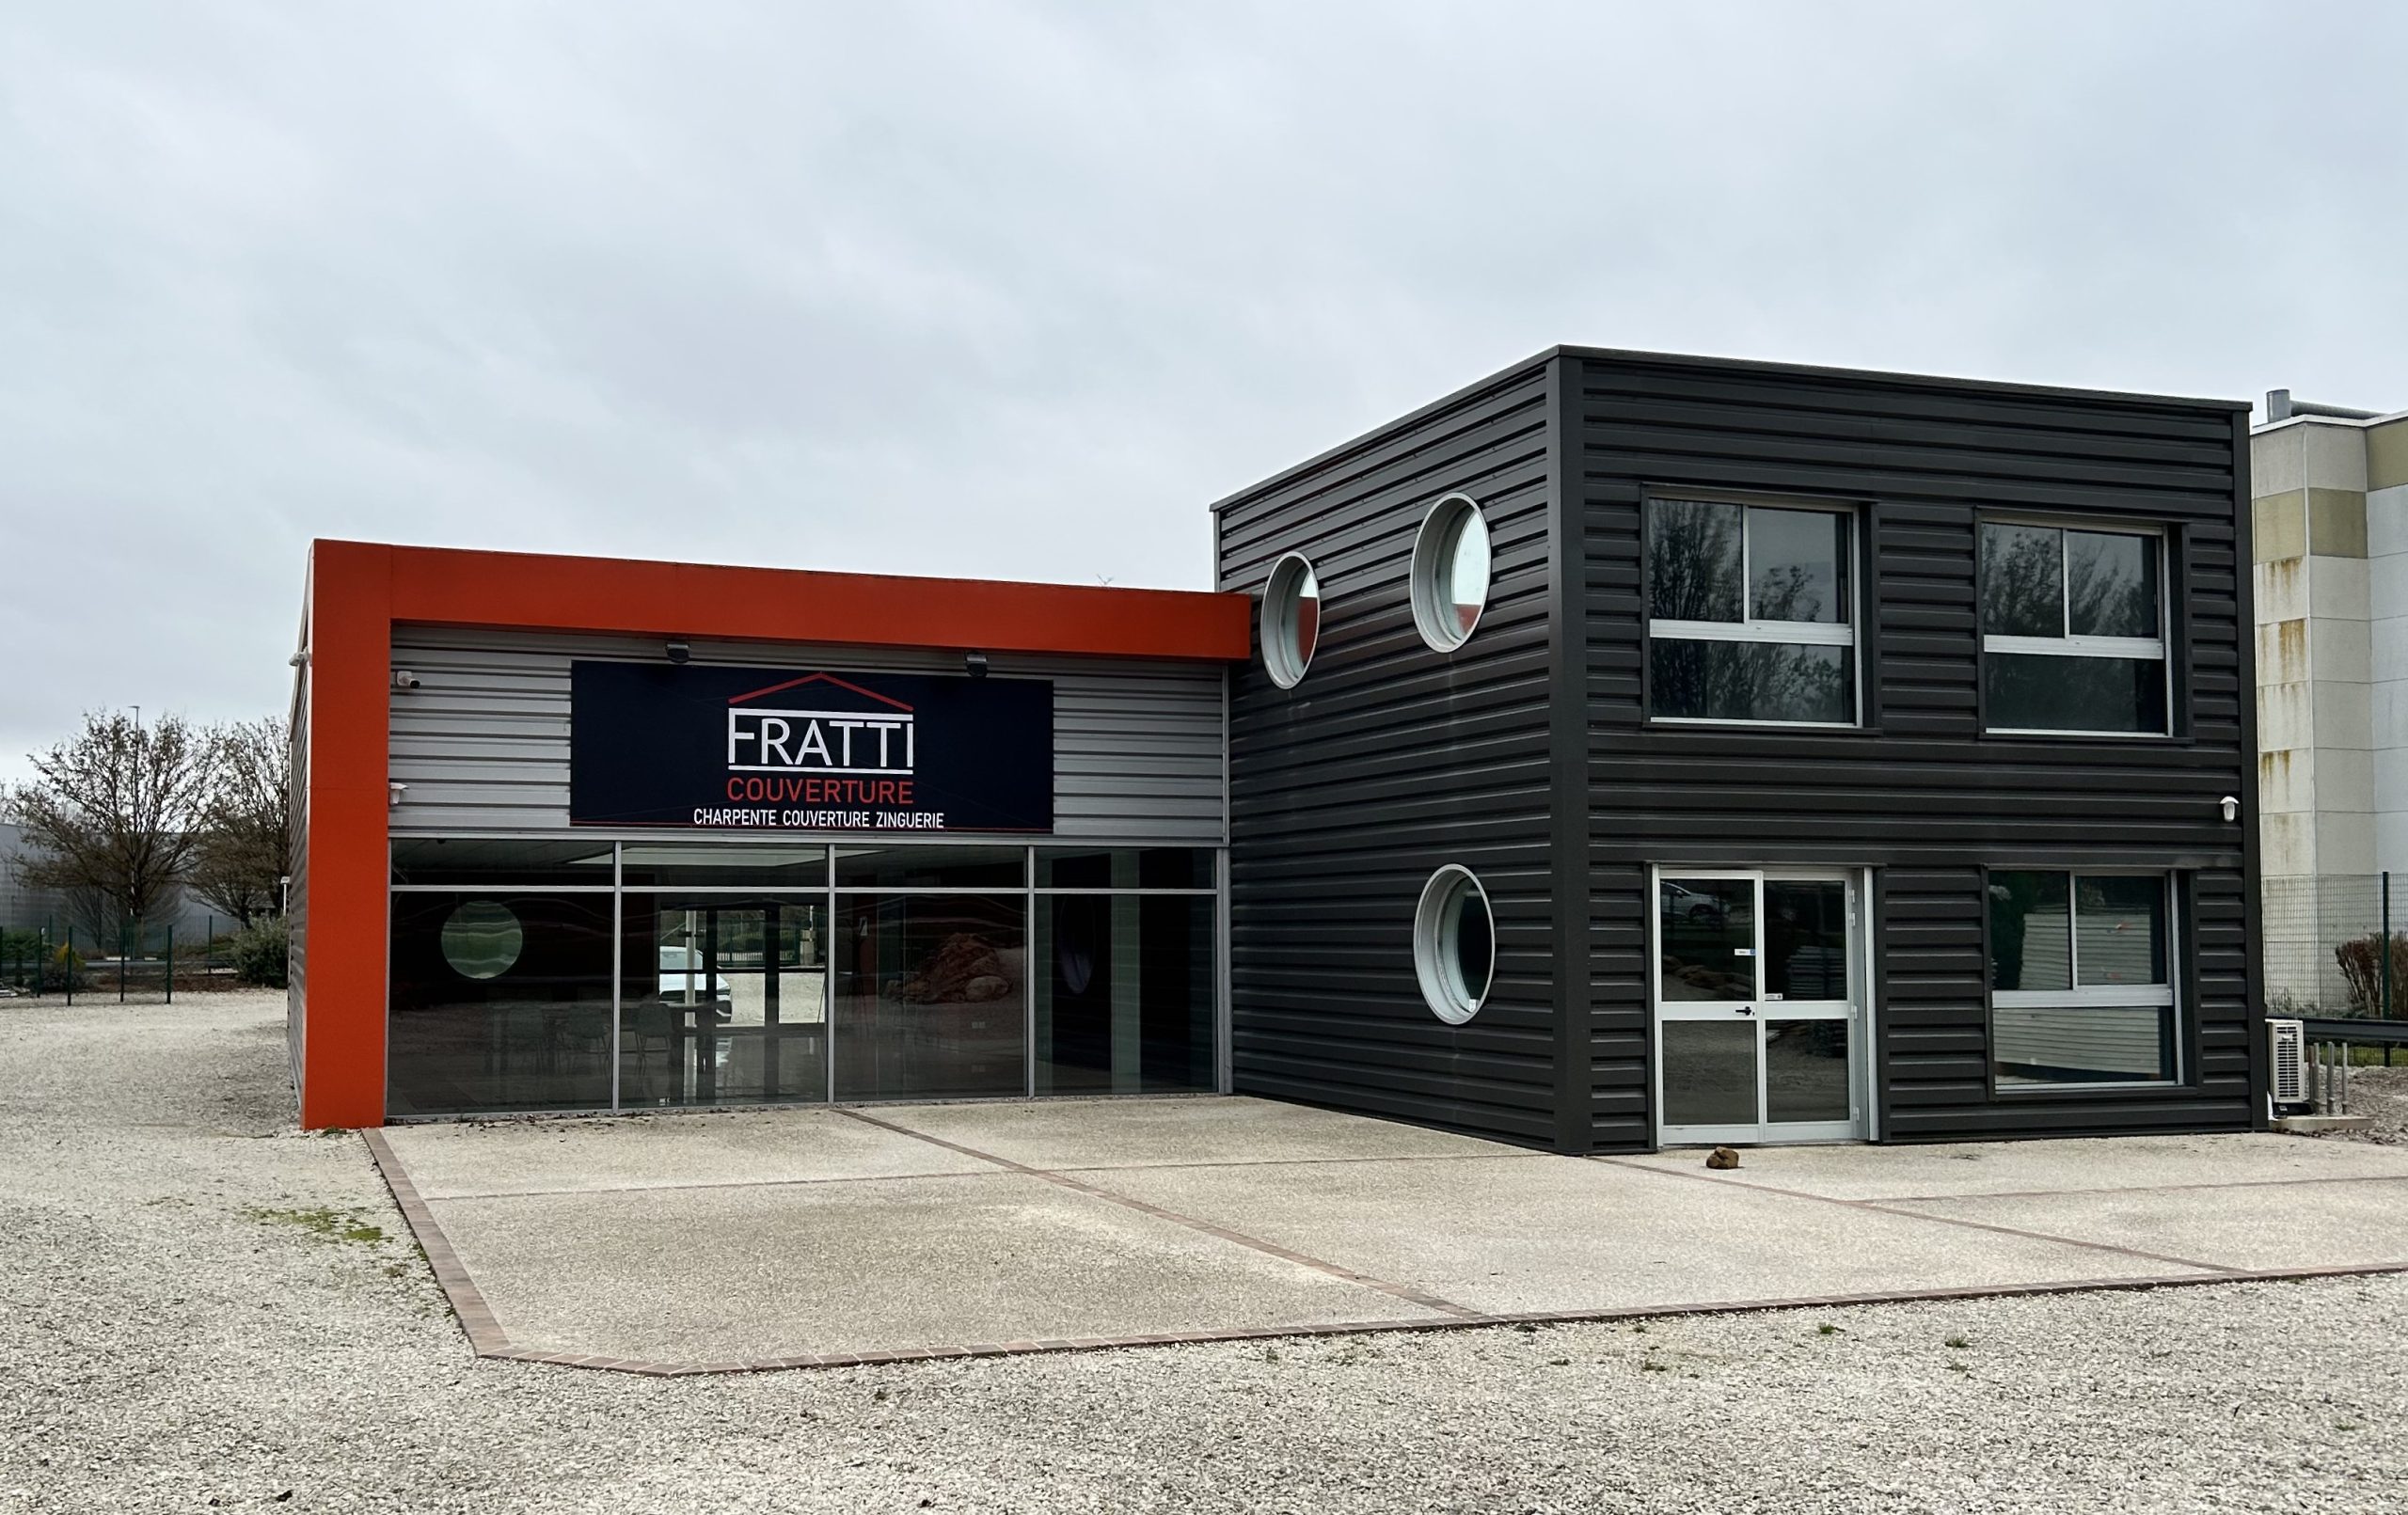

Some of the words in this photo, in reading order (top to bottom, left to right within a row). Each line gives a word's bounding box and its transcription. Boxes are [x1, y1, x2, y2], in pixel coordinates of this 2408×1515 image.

[728, 707, 913, 767] FRATTI
[727, 777, 913, 804] COUVERTURE
[693, 808, 777, 826] CHARPENTE
[783, 810, 870, 828] COUVERTURE
[876, 812, 944, 829] ZINGUERIE
